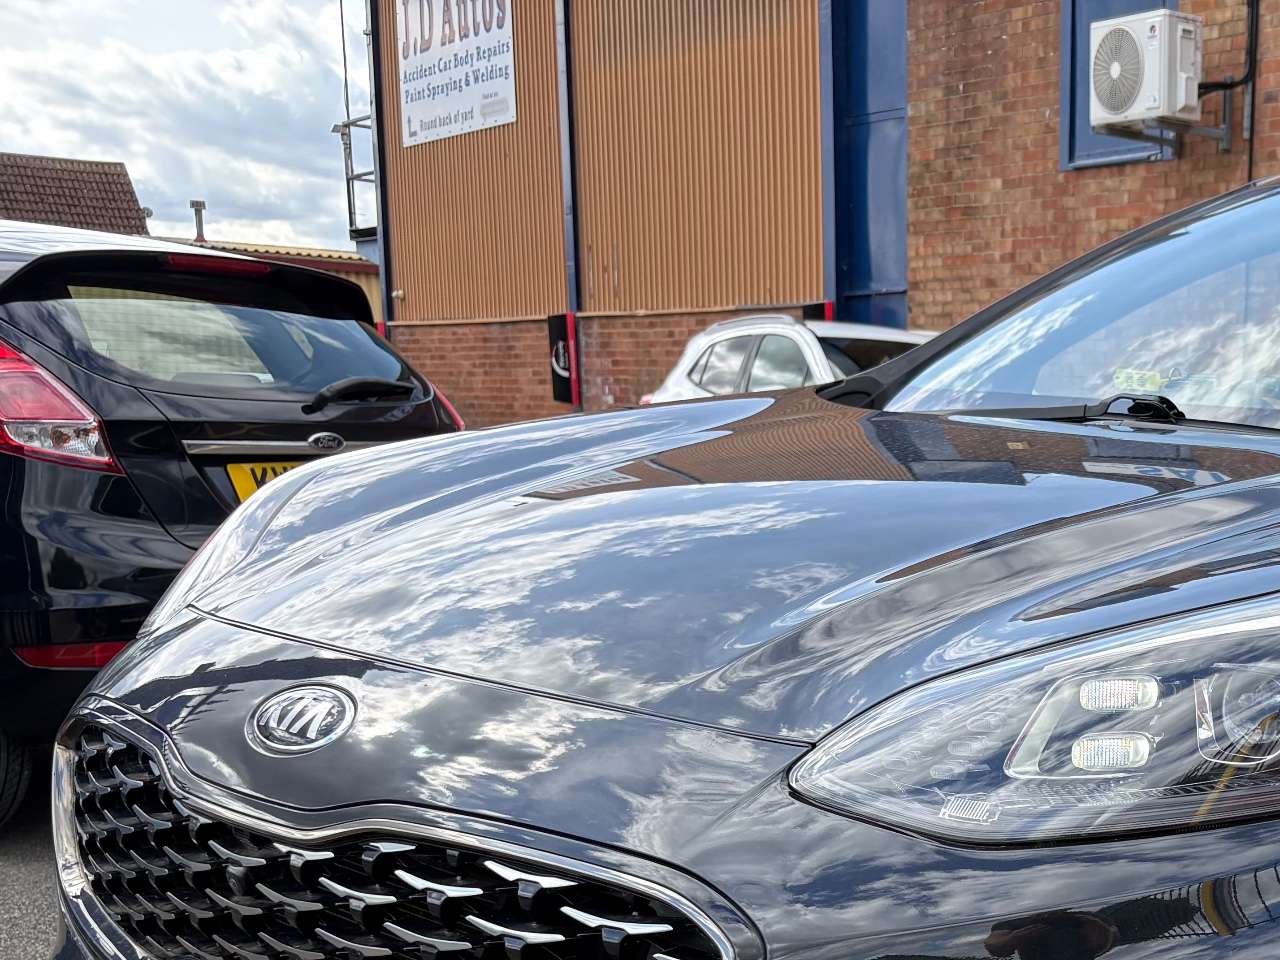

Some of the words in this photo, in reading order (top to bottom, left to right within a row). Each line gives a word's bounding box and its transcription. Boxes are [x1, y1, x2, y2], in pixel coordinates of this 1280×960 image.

[440, 0, 506, 47] Autos
[403, 63, 437, 84] Accident
[437, 57, 451, 73] Car
[453, 49, 474, 71] Body
[476, 40, 511, 62] Repairs
[405, 86, 426, 104] Paint
[427, 78, 463, 101] Spraying
[464, 72, 471, 88] &
[472, 64, 510, 84] Welding
[420, 116, 438, 132] Round
[438, 112, 453, 128] back
[453, 109, 460, 124] of
[460, 106, 474, 125] yard
